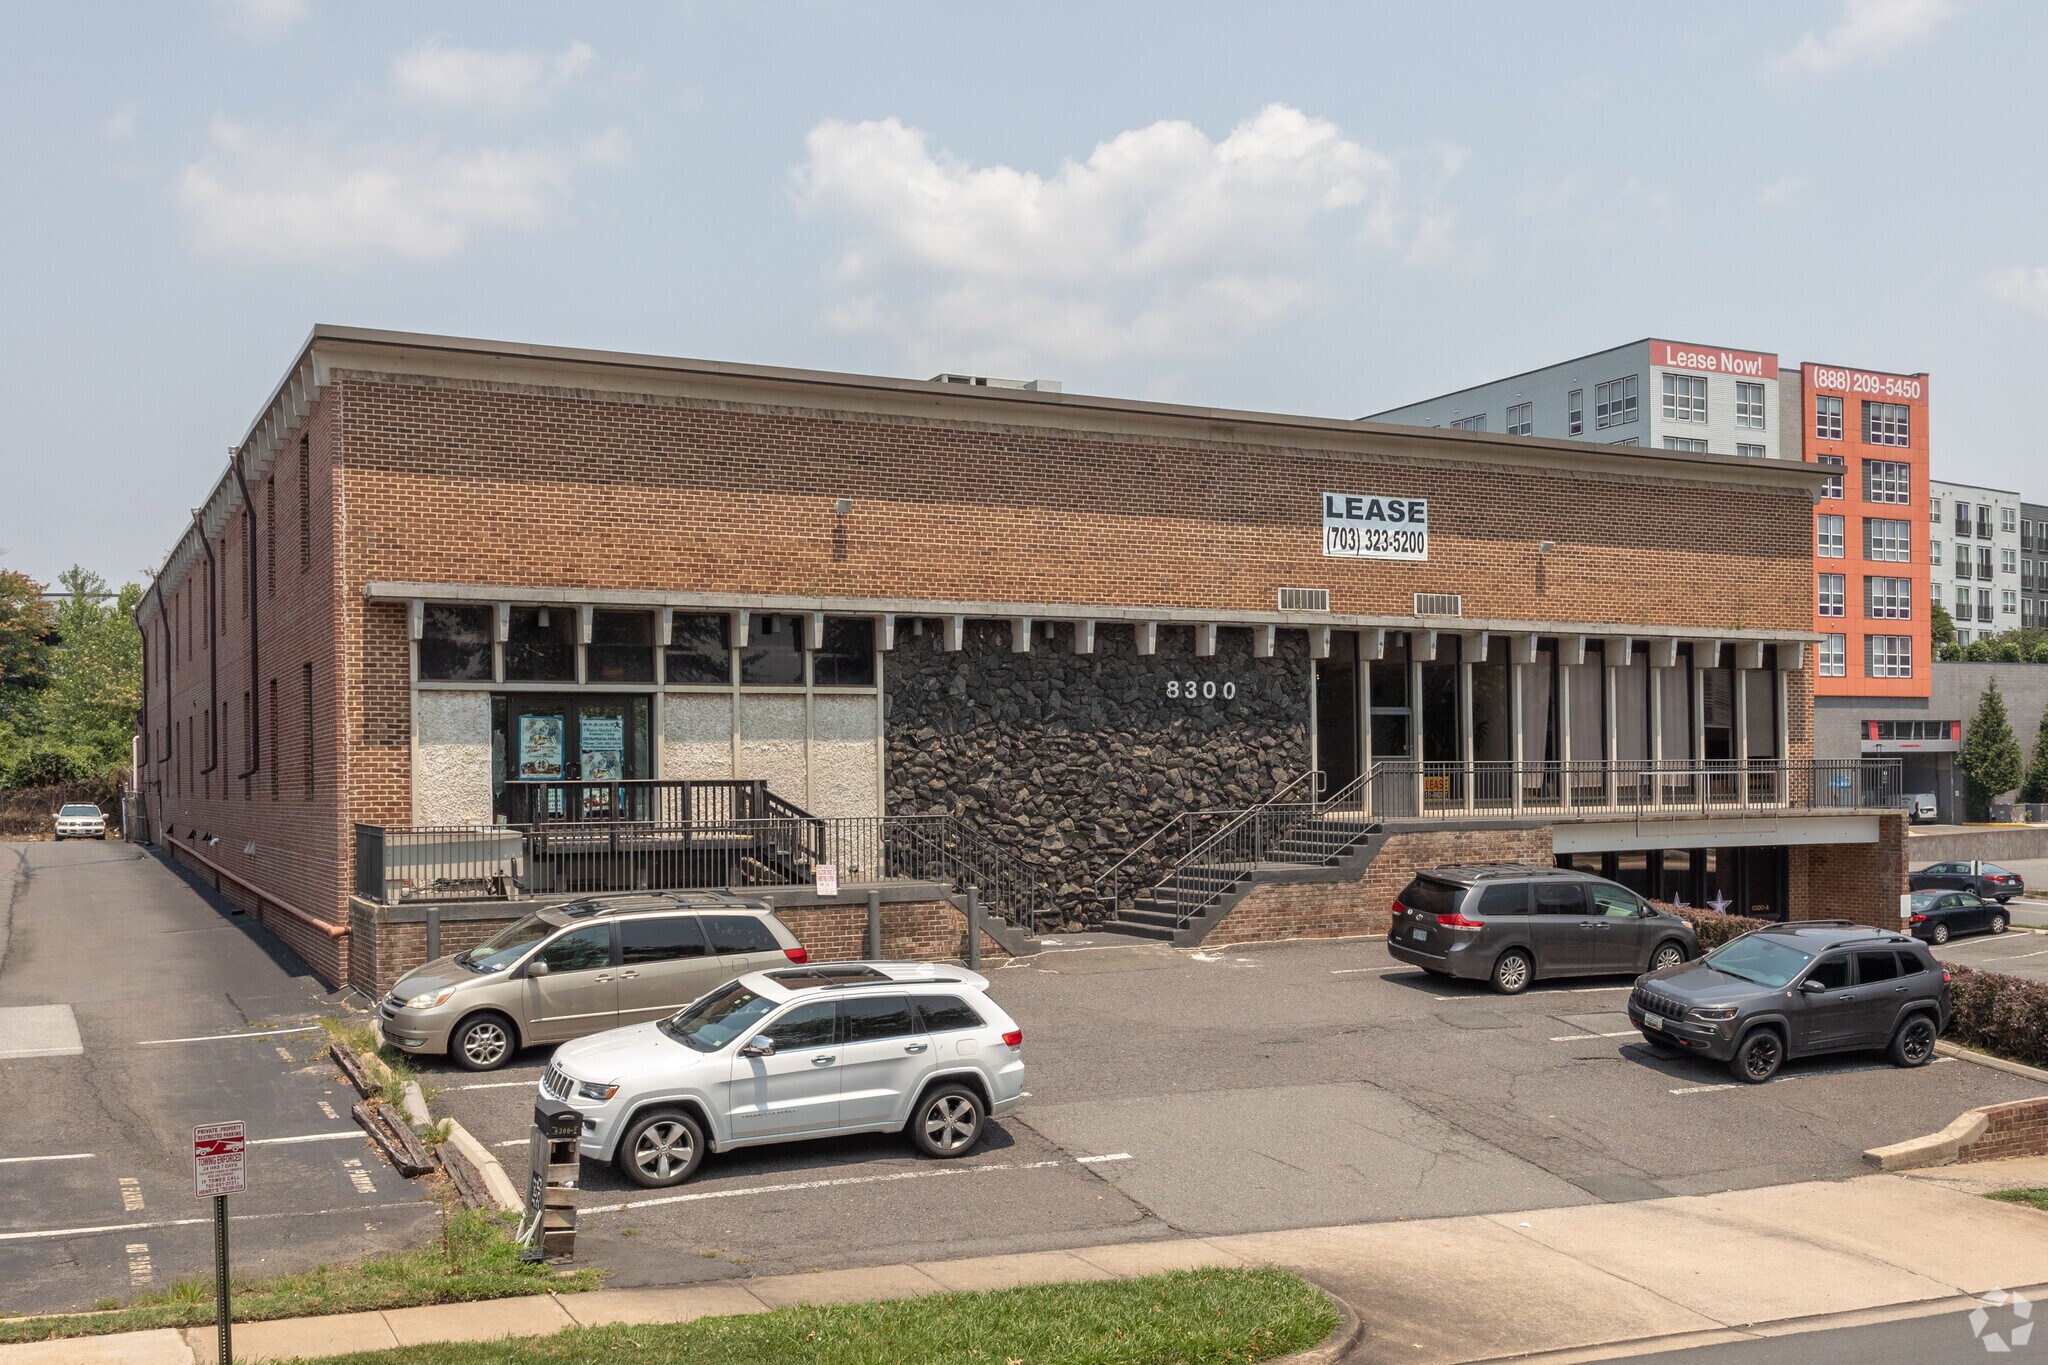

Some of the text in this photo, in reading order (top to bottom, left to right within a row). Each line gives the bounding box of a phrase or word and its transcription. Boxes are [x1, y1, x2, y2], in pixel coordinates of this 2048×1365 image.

[1666, 346, 1763, 375] Lease Now!
[1813, 366, 1921, 399] (888) 209-5450
[1326, 496, 1425, 523] LEASE
[1327, 526, 1424, 556] (703) 323-5200
[1166, 681, 1236, 700] 8300
[198, 1153, 242, 1166] TOWING ENFORCED
